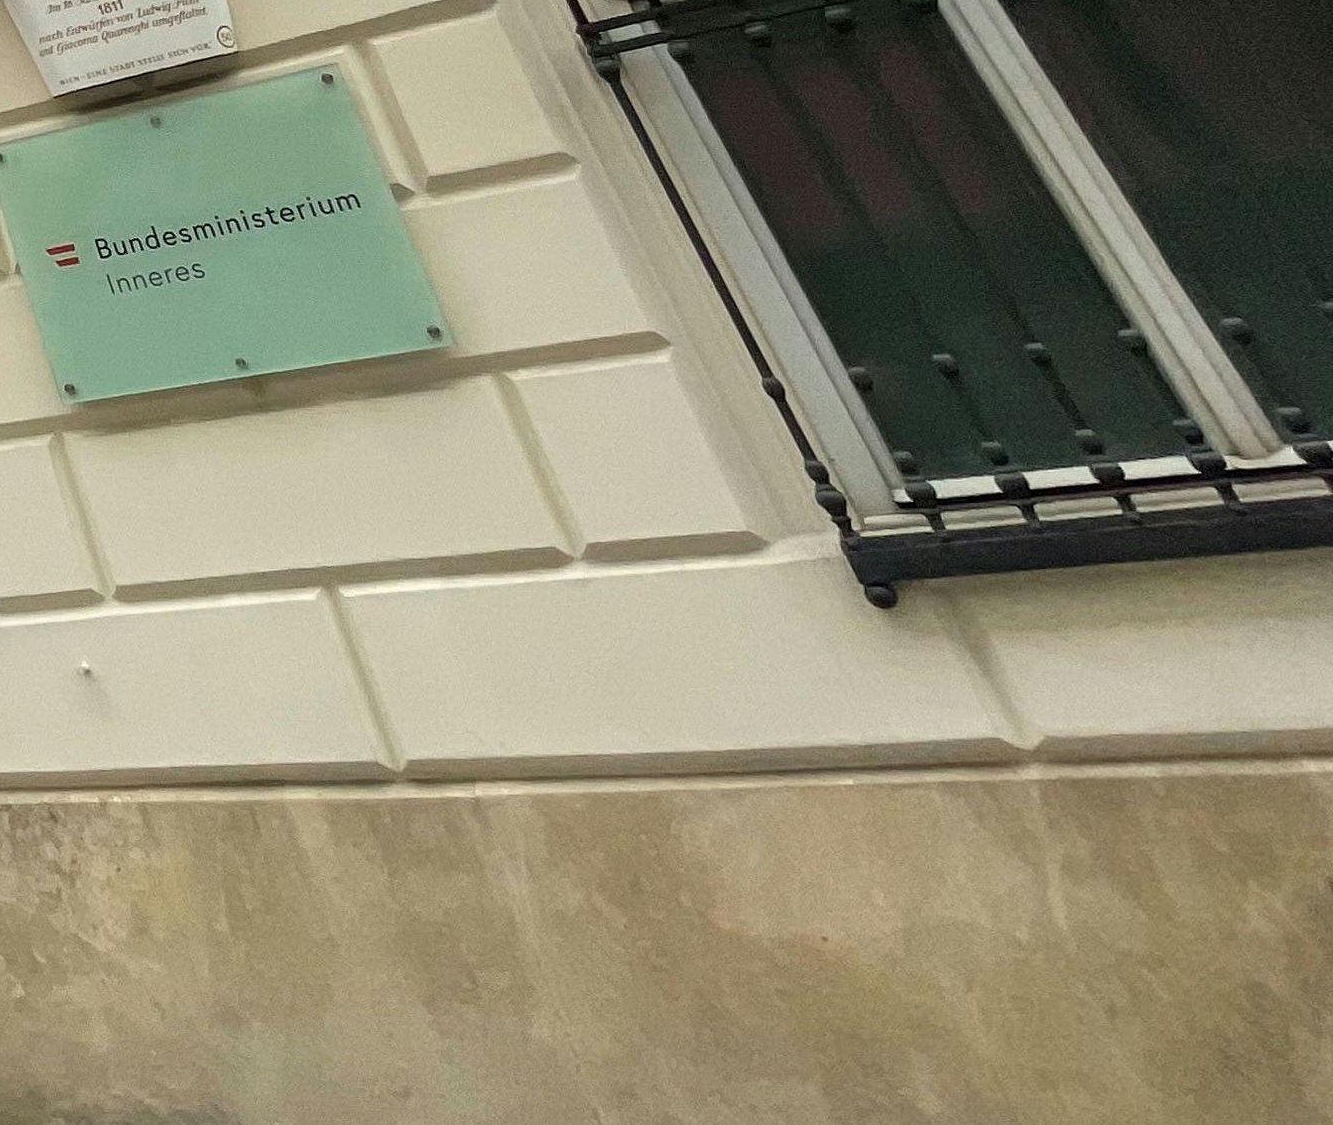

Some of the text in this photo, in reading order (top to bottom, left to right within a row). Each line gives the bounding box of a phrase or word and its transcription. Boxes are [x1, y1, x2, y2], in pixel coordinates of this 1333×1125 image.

[39, 29, 64, 44] nach
[116, 13, 133, 23] von
[137, 2, 171, 18] Ludwig
[98, 0, 124, 15] 1811
[95, 193, 362, 260] Bundesministerium
[107, 262, 206, 295] Inneres
